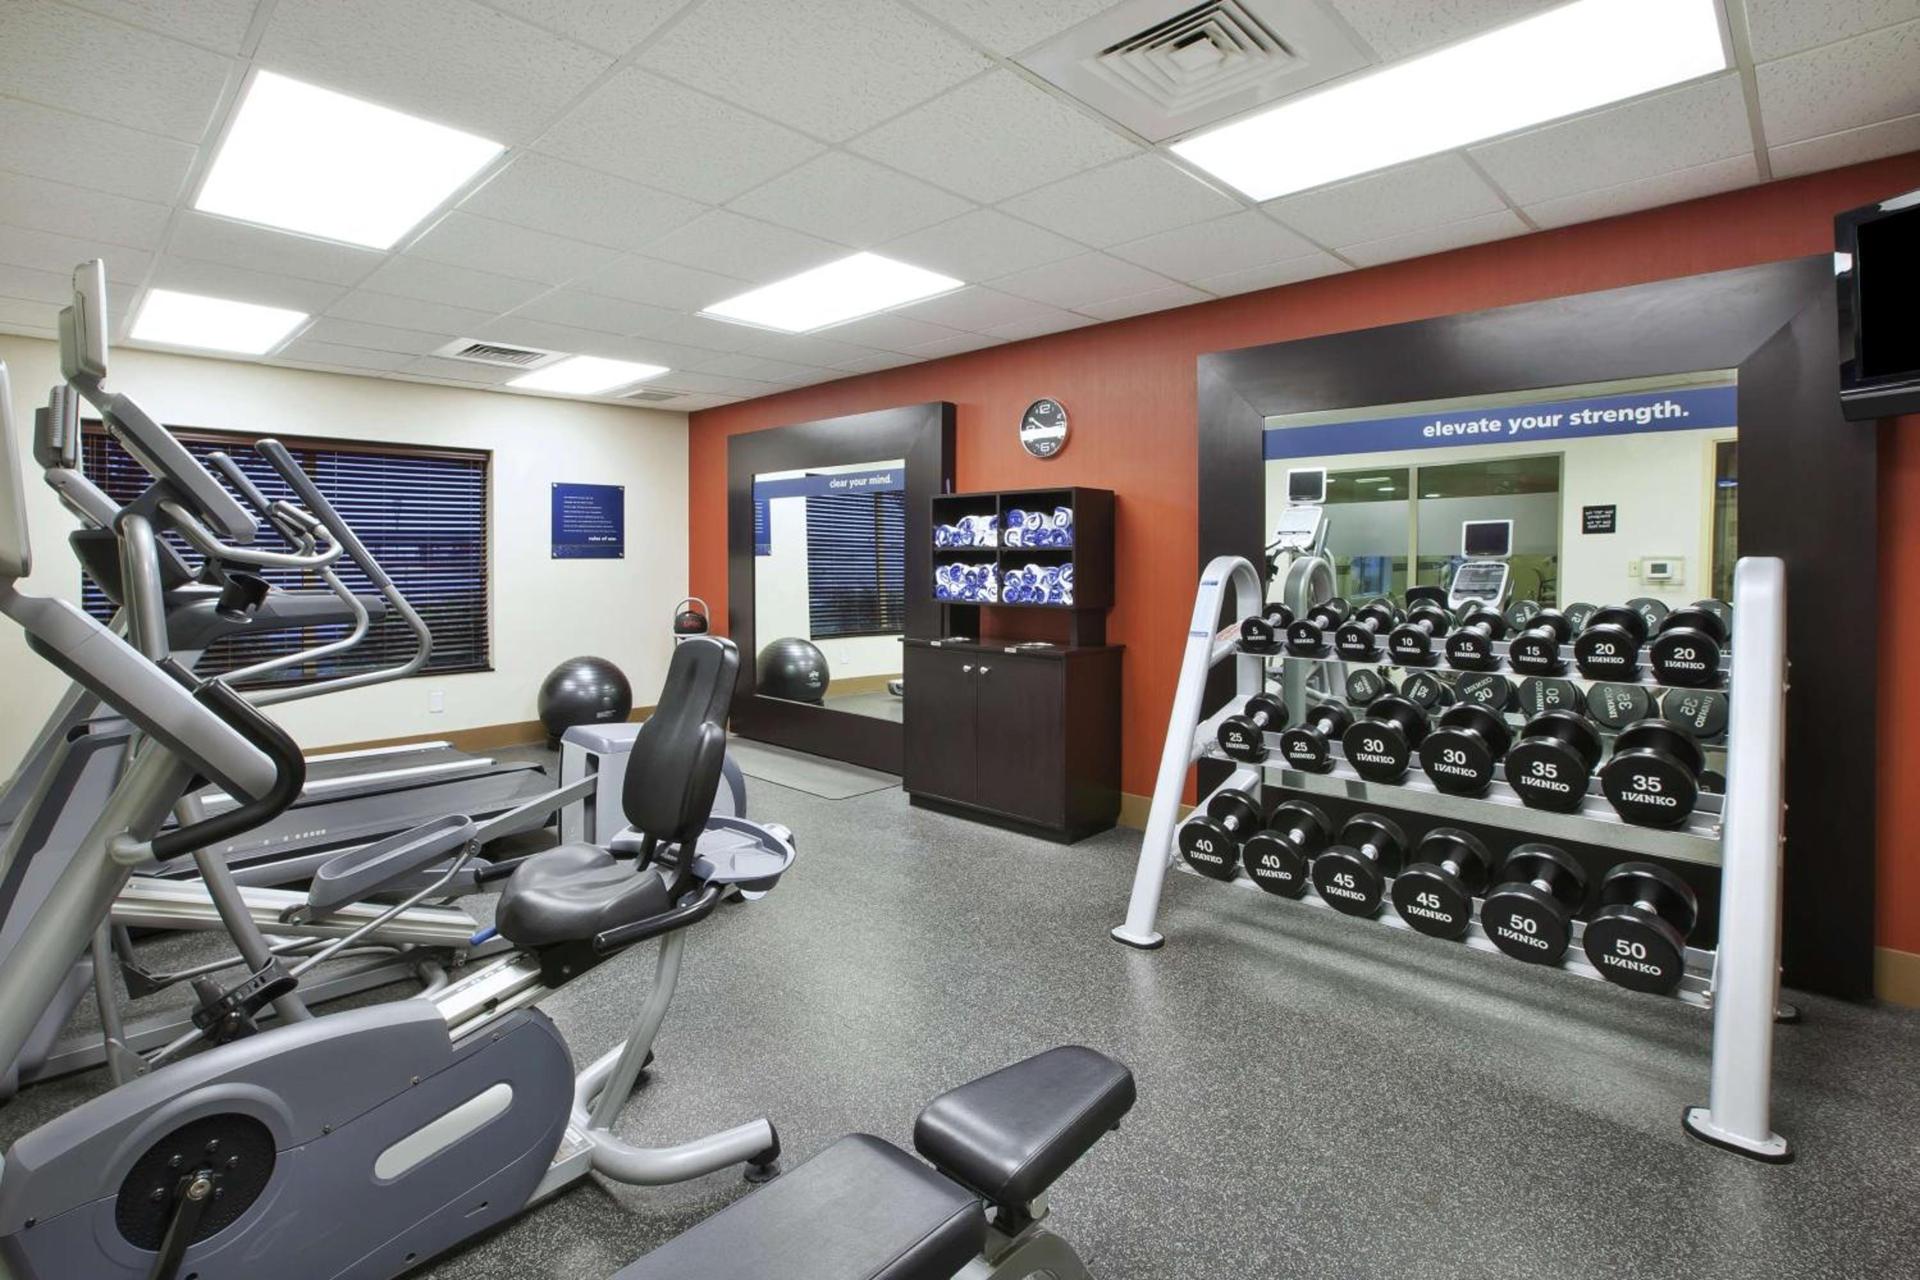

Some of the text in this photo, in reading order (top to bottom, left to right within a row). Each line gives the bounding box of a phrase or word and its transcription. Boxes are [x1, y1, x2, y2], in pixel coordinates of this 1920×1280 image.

[1423, 400, 1690, 437] elevate your strength.
[829, 473, 893, 489] clear your mind.
[1252, 626, 1259, 635] 5
[1300, 629, 1307, 639] 5
[1347, 634, 1358, 643] 10
[1402, 637, 1413, 647] 10
[1460, 642, 1473, 652] 15
[1526, 646, 1540, 656] 15
[1595, 643, 1615, 655] 20
[1673, 648, 1695, 660] 20
[1587, 655, 1625, 665] IVANKO
[1664, 660, 1705, 670] IVANKO
[1229, 732, 1242, 742] 25
[1293, 742, 1307, 752] 25
[1363, 739, 1384, 753] 30
[1357, 752, 1395, 765] IVANKO
[1443, 749, 1466, 765] 30
[1434, 763, 1477, 778] IVANKO
[1532, 761, 1558, 778] 35
[1521, 775, 1570, 792] IVANKO
[1632, 775, 1662, 792] 35
[1622, 791, 1677, 807] IVANKO
[1196, 839, 1213, 853] 40
[1190, 851, 1223, 864] IVANKO
[1262, 855, 1281, 869] 40
[1256, 868, 1292, 880] IVANKO
[1333, 873, 1355, 888] 45
[1326, 884, 1366, 902] IVANKO
[1416, 892, 1440, 909] 45
[1407, 905, 1452, 923] IVANKO
[1510, 914, 1537, 934] 50
[1498, 926, 1548, 950] IVANKO
[1616, 939, 1647, 960] 50
[1604, 955, 1662, 977] IVANKO
